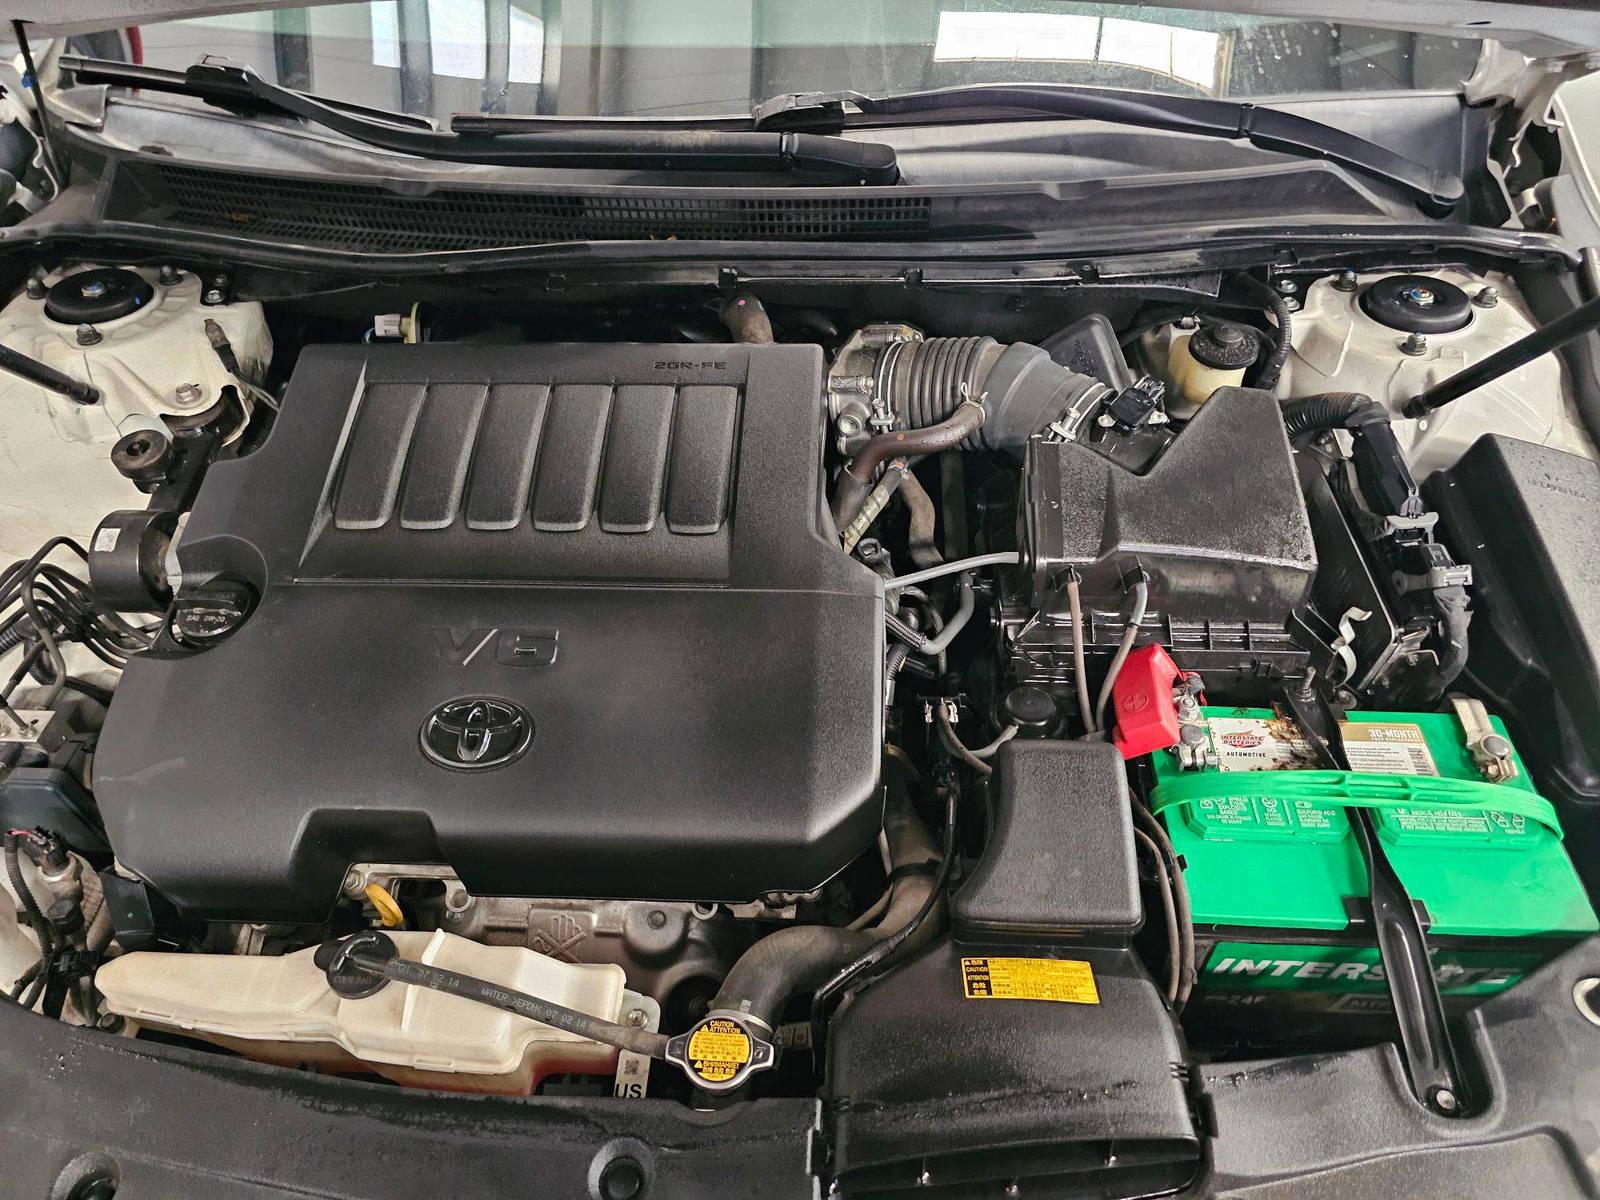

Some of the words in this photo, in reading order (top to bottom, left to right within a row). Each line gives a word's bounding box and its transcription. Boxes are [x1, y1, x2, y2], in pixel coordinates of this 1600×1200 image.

[654, 361, 727, 370] 2GR-FE
[186, 614, 200, 622] SAE
[203, 615, 226, 623] 0W-20
[431, 628, 560, 666] V6
[1368, 728, 1420, 739] 30-MONTH
[448, 977, 460, 987] 14
[481, 987, 509, 1001] WATER
[546, 1008, 558, 1019] 07
[562, 1014, 574, 1025] 02
[576, 1019, 587, 1030] 14
[709, 1020, 735, 1028] CAUTION
[709, 1026, 741, 1034] ATTENTION
[615, 1083, 642, 1098] US
